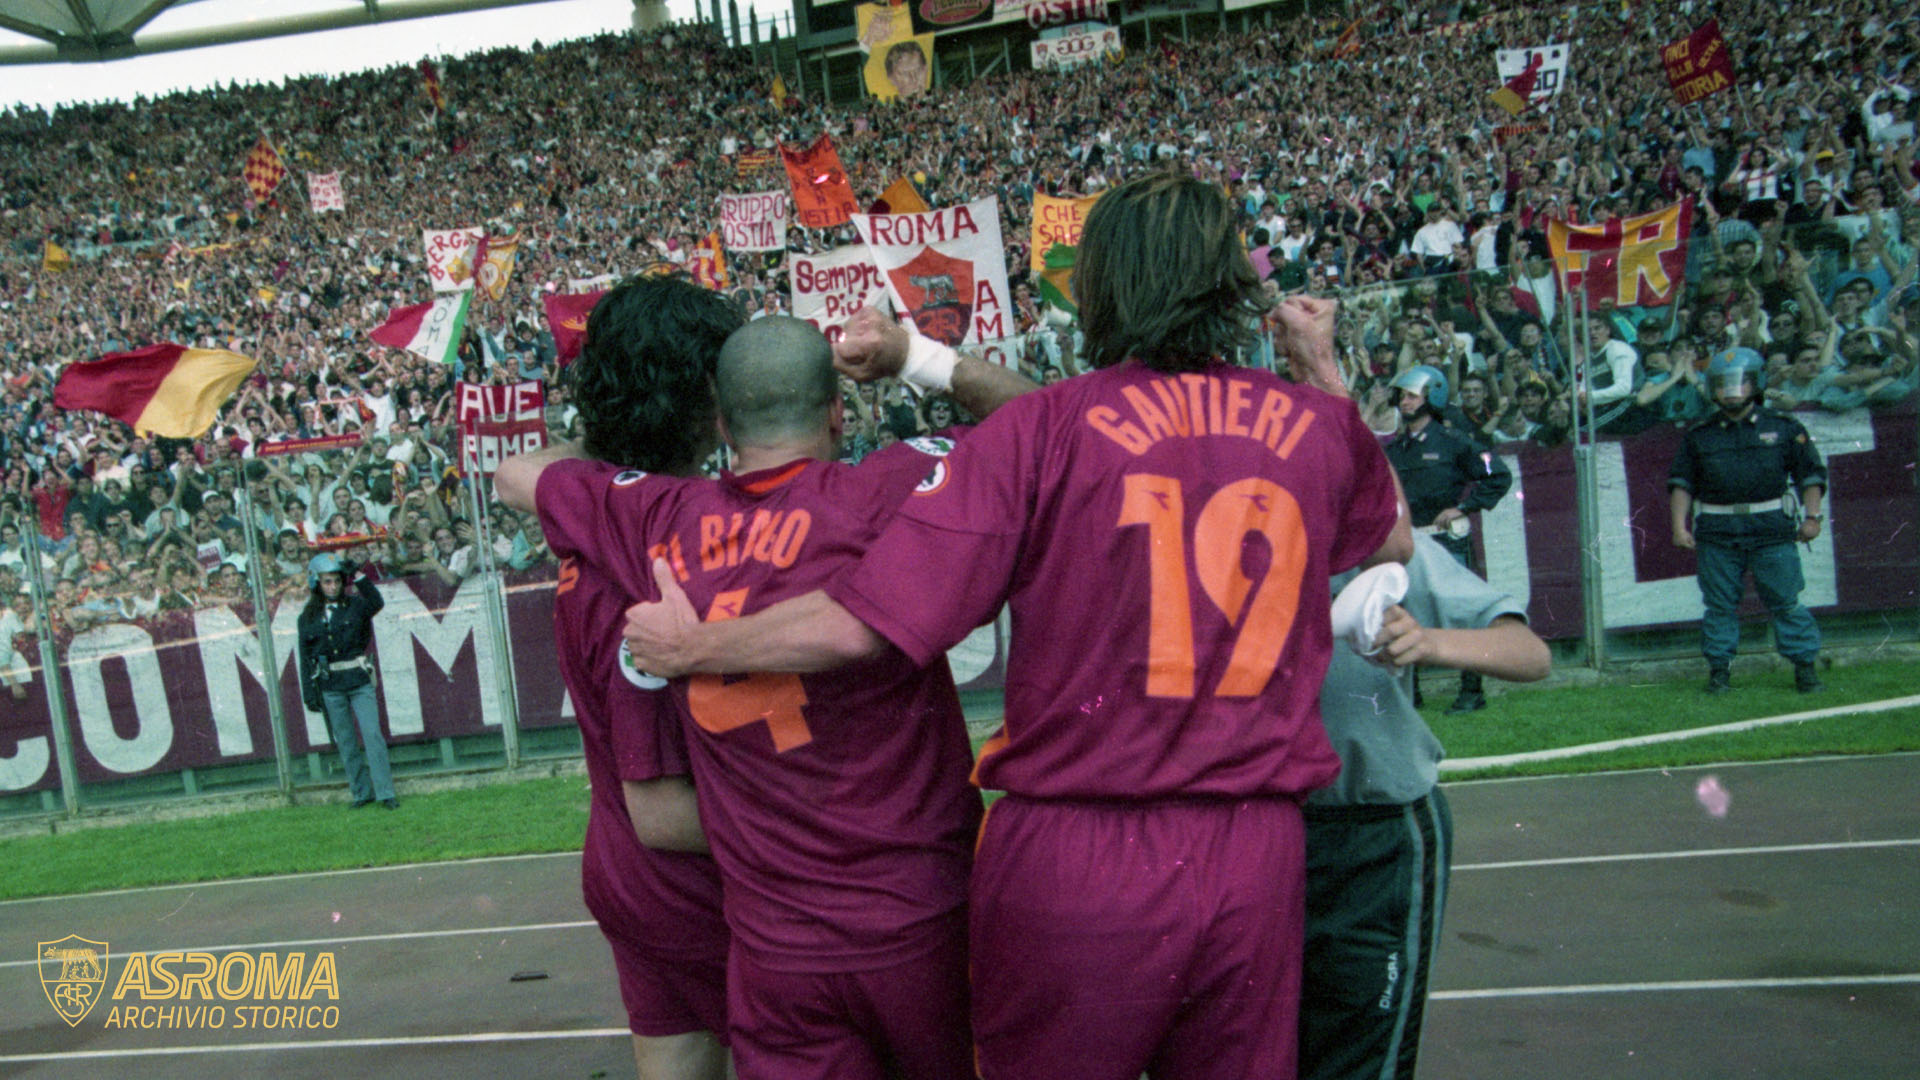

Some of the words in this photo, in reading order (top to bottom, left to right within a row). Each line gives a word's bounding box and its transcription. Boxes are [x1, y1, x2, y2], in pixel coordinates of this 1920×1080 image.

[868, 205, 979, 246] ROMA
[1043, 204, 1082, 223] CHE
[723, 221, 776, 248] OSTIA
[1086, 373, 1316, 460] GAUTIERI
[1116, 473, 1308, 698] 19
